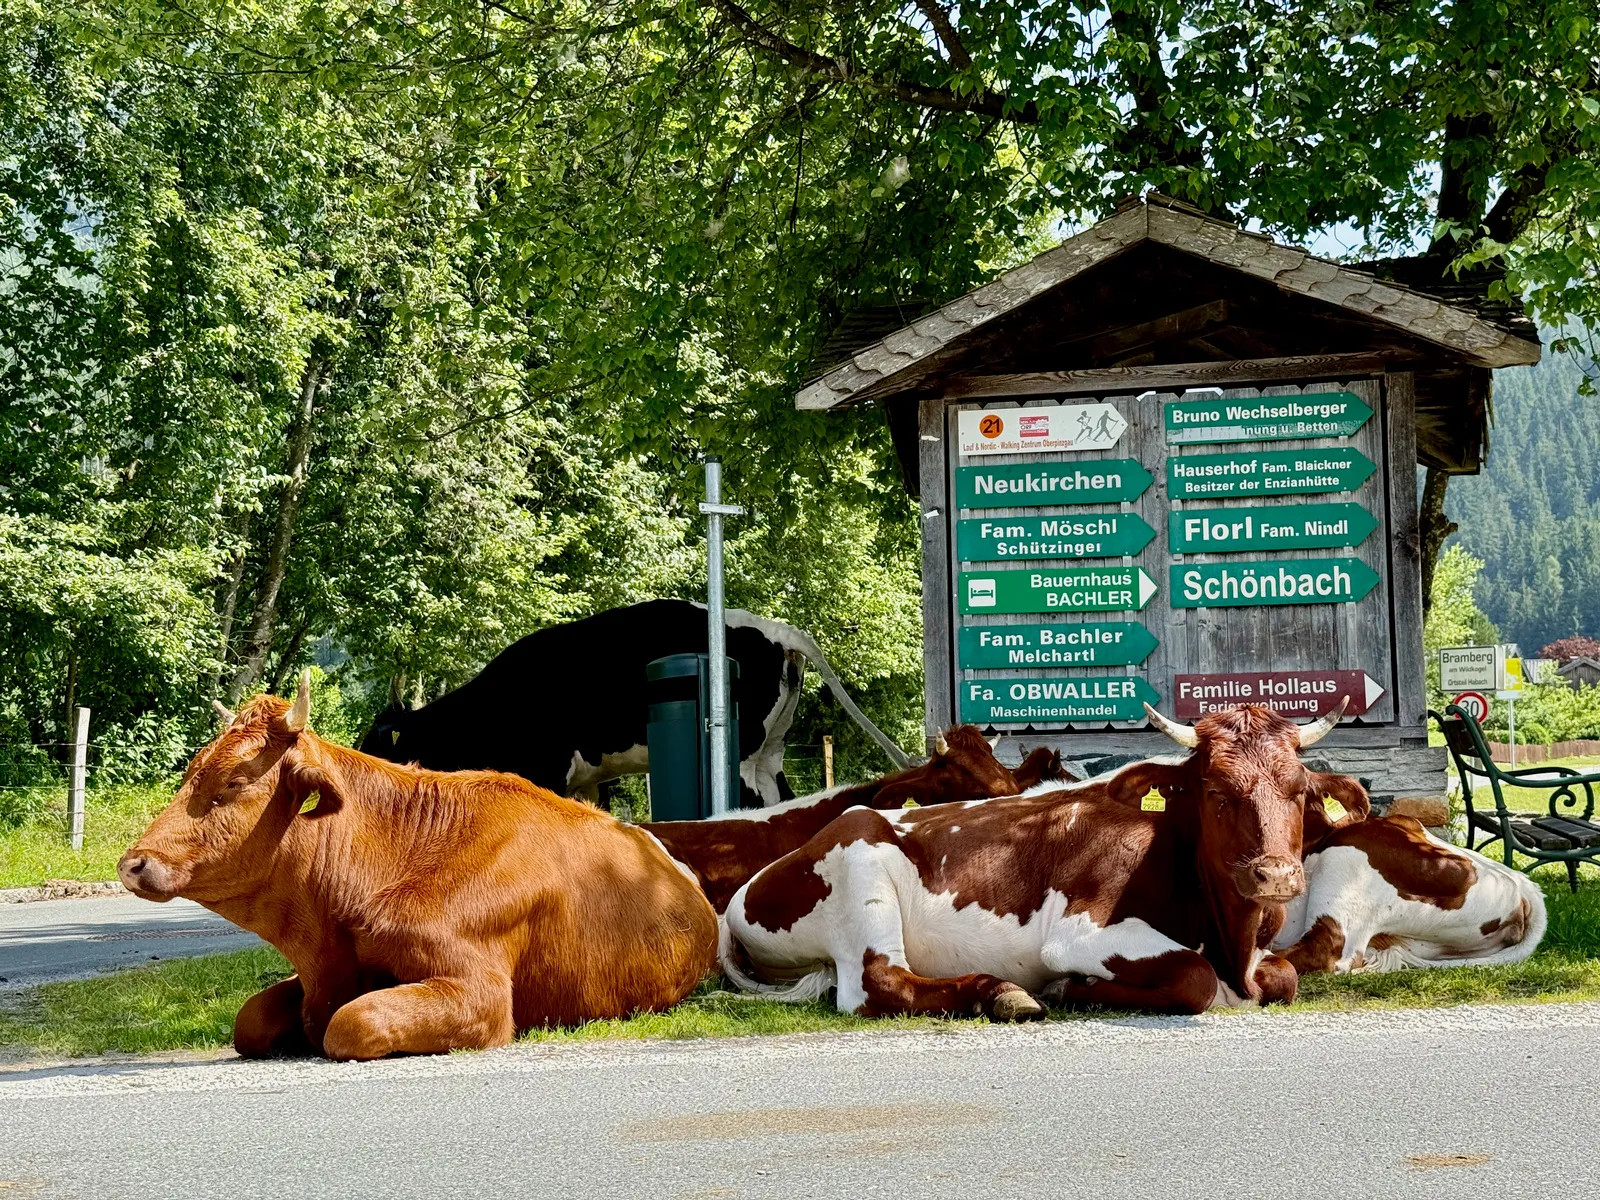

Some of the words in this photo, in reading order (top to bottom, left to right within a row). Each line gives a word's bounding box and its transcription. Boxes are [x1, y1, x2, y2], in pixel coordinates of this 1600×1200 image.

[1172, 410, 1220, 423] Bruno
[1226, 403, 1347, 421] Wechselberger
[983, 419, 1001, 433] 21
[1297, 422, 1338, 432] Betten
[963, 443, 975, 451] Lauf
[975, 443, 980, 451] &
[980, 442, 996, 450] Nordic
[1000, 441, 1020, 450] Walking
[1021, 440, 1041, 448] Zentrum
[1173, 460, 1257, 477] Hauserhof
[1262, 463, 1291, 473] Fam.
[1295, 460, 1352, 472] Blaickner
[975, 471, 1121, 494] Neukirchen
[1185, 480, 1234, 492] Besitzer
[1239, 478, 1259, 490] der
[1264, 476, 1339, 489] Enzianhütte
[981, 523, 1032, 538] Fam.
[1041, 519, 1117, 537] Möschl
[1184, 516, 1253, 541] Florl
[1260, 523, 1300, 538] Fam.
[1305, 520, 1348, 536] Nindl
[997, 541, 1102, 555] Schützinger
[1030, 573, 1132, 588] Bauernhaus
[1183, 565, 1351, 600] Schönbach
[1046, 591, 1133, 606] BACHLER
[980, 632, 1031, 646] Fam.
[1040, 629, 1123, 645] Bachler
[1008, 648, 1095, 663] Melchartl
[1442, 652, 1492, 664] Bramberg
[970, 685, 1001, 700] Fa.
[1009, 682, 1136, 699] OBWALLER
[1179, 680, 1252, 698] Familie
[1259, 678, 1337, 696] Hollaus
[990, 704, 1117, 717] Maschinenhandel
[1462, 700, 1479, 718] 30
